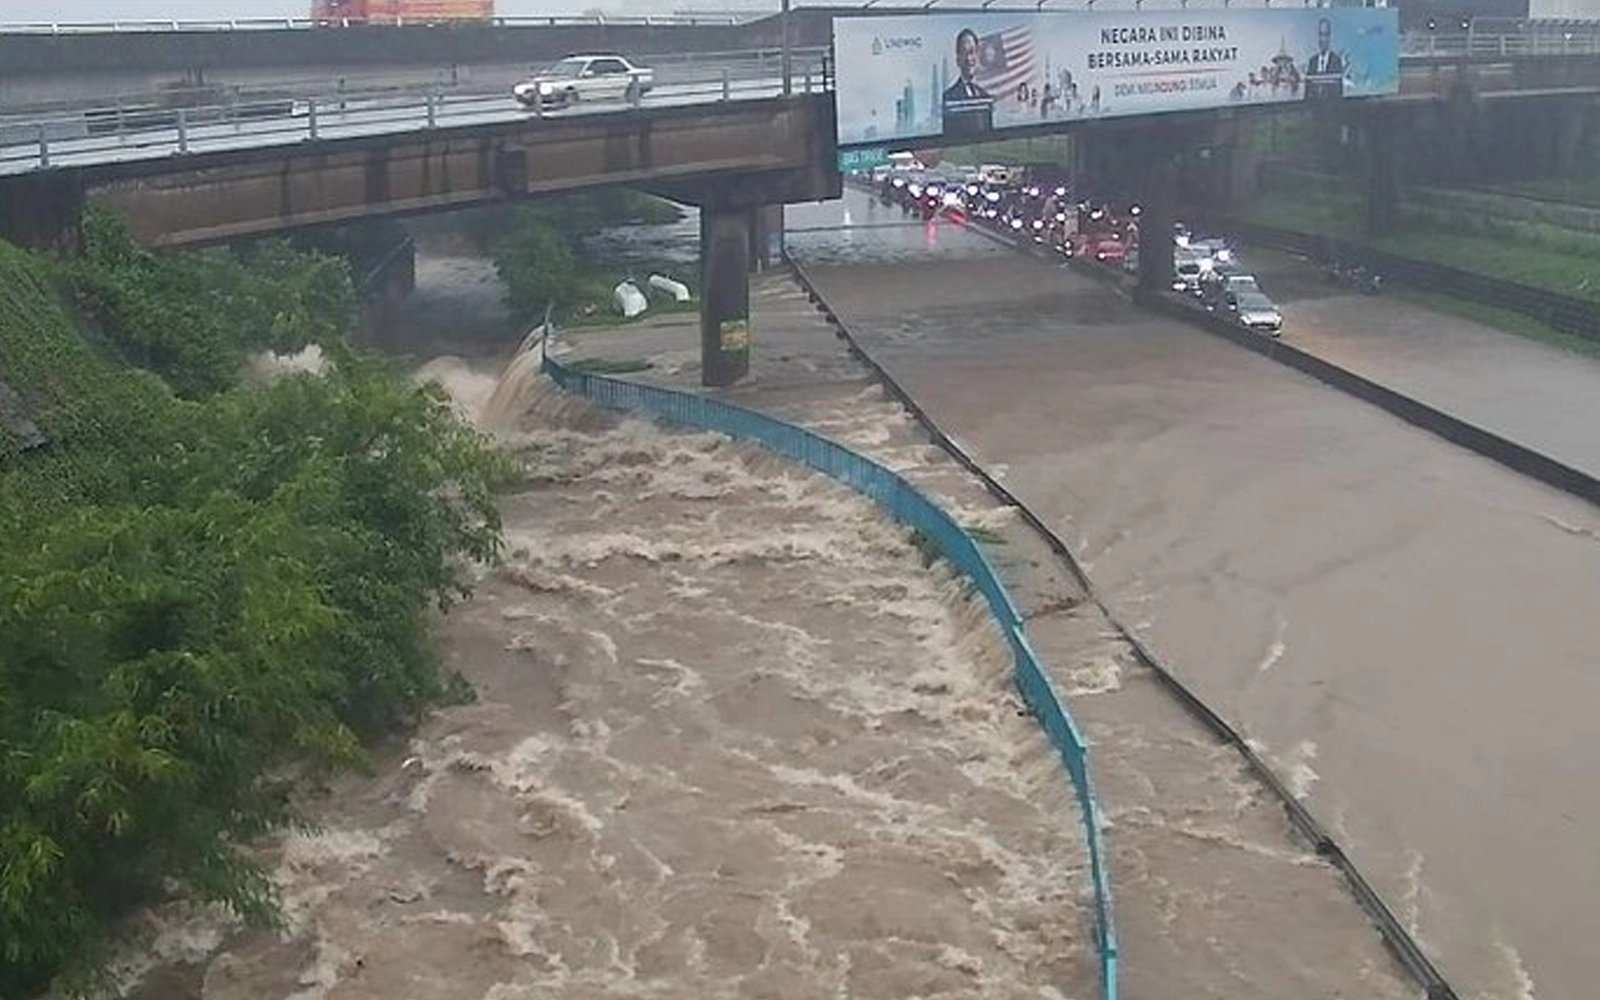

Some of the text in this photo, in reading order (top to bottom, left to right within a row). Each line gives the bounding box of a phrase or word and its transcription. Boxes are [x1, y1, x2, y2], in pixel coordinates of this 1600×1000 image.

[1101, 26, 1226, 43] NEGARA INI DIBINA
[1088, 47, 1239, 68] BERSAMA-SAMA RAKYAT
